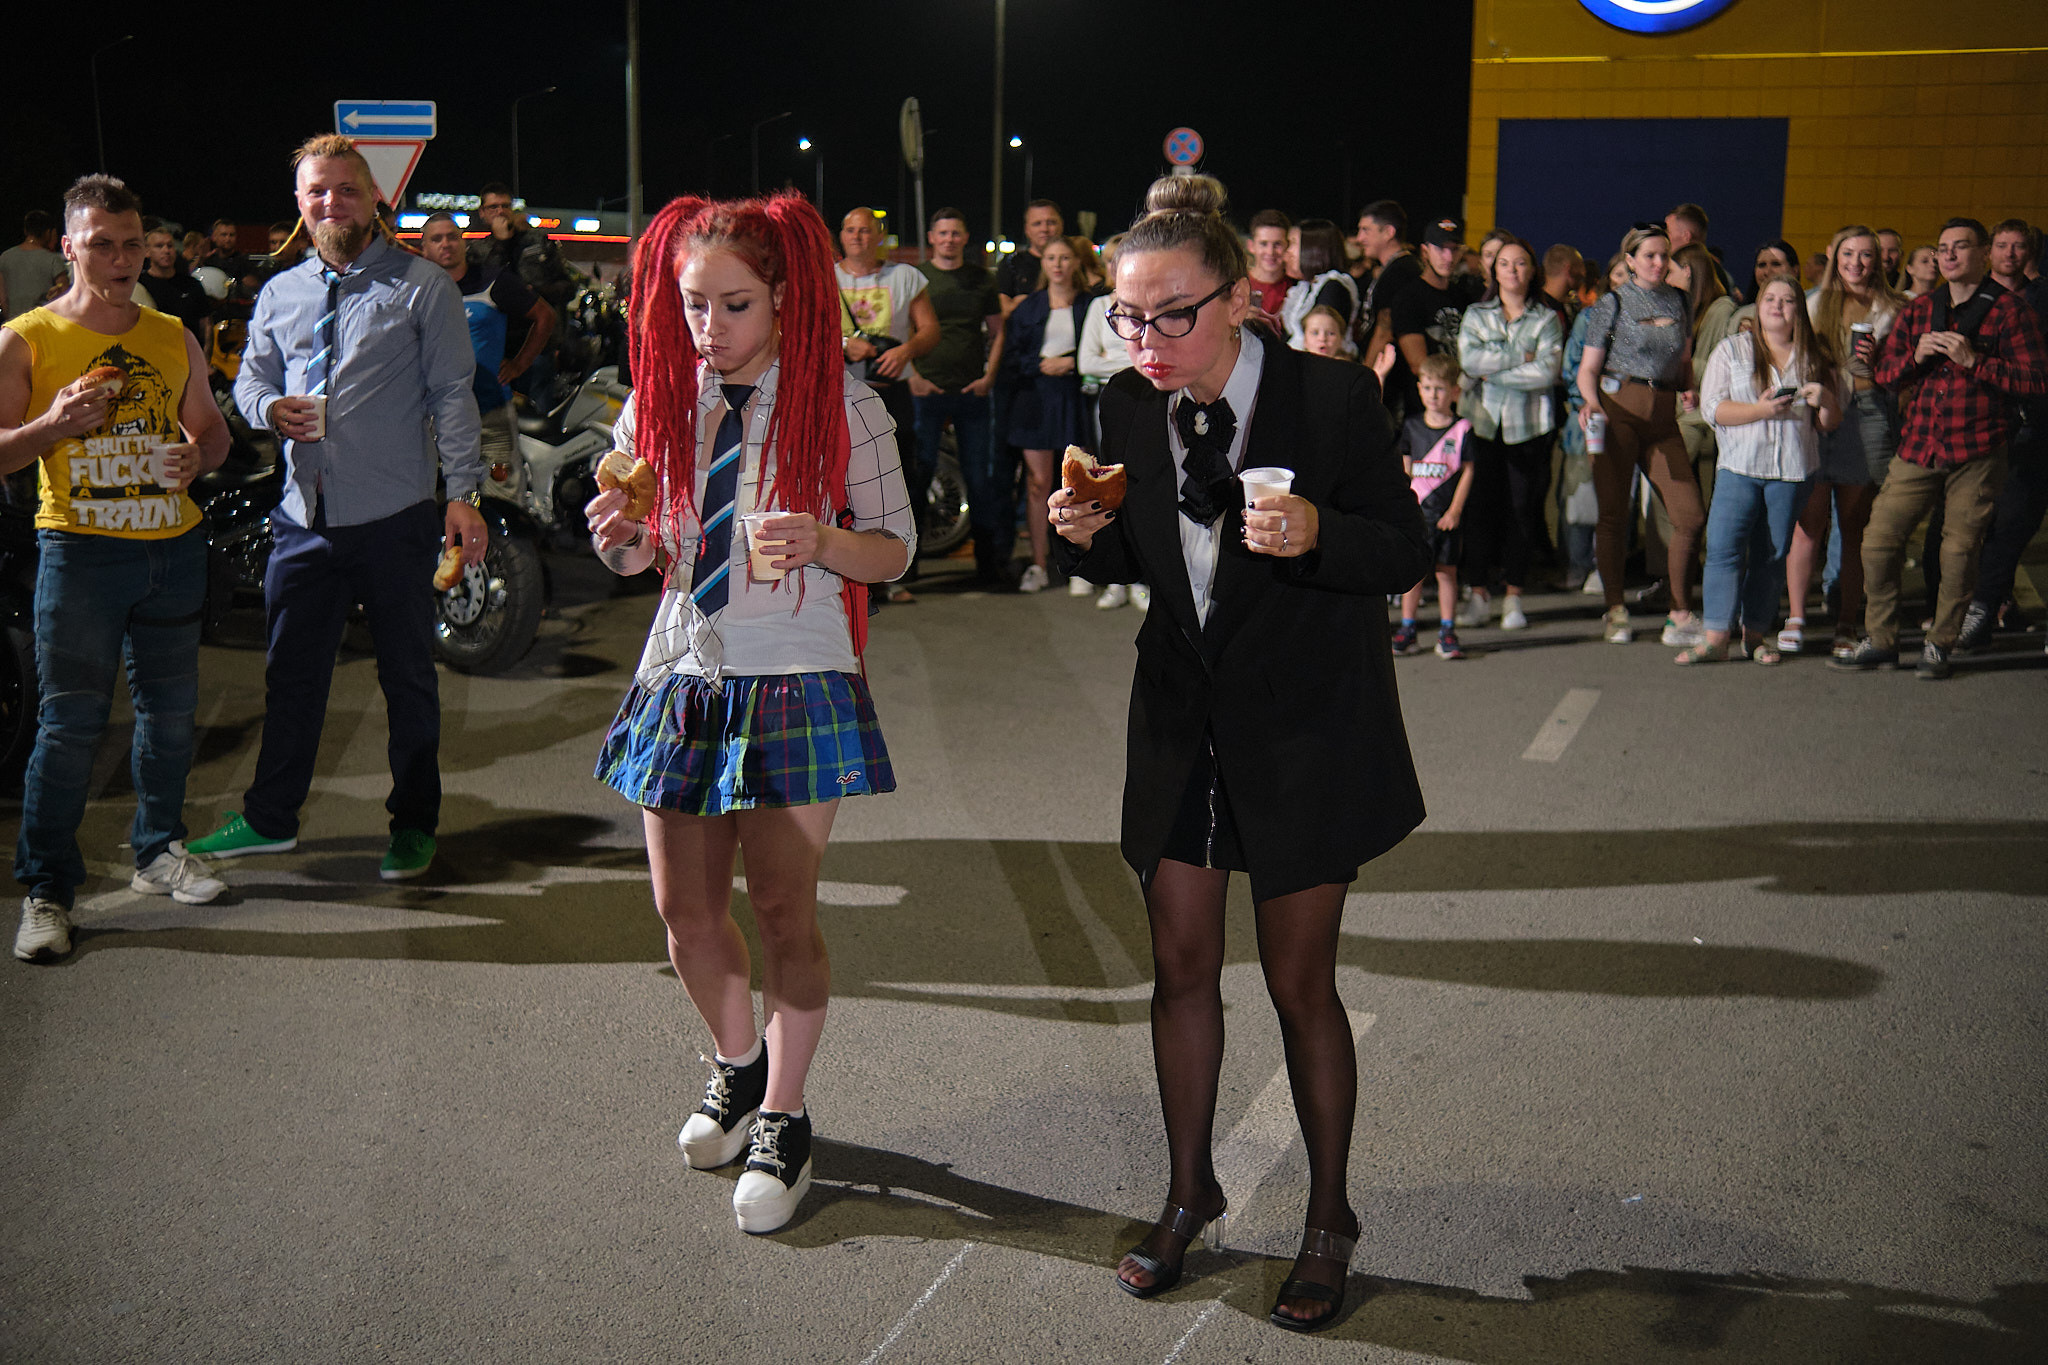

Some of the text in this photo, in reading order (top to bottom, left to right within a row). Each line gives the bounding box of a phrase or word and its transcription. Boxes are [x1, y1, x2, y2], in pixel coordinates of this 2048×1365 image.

[85, 436, 133, 456] SHUT
[70, 455, 152, 487] FUCK
[78, 487, 170, 498] AN
[70, 495, 182, 530] TRAIN!
